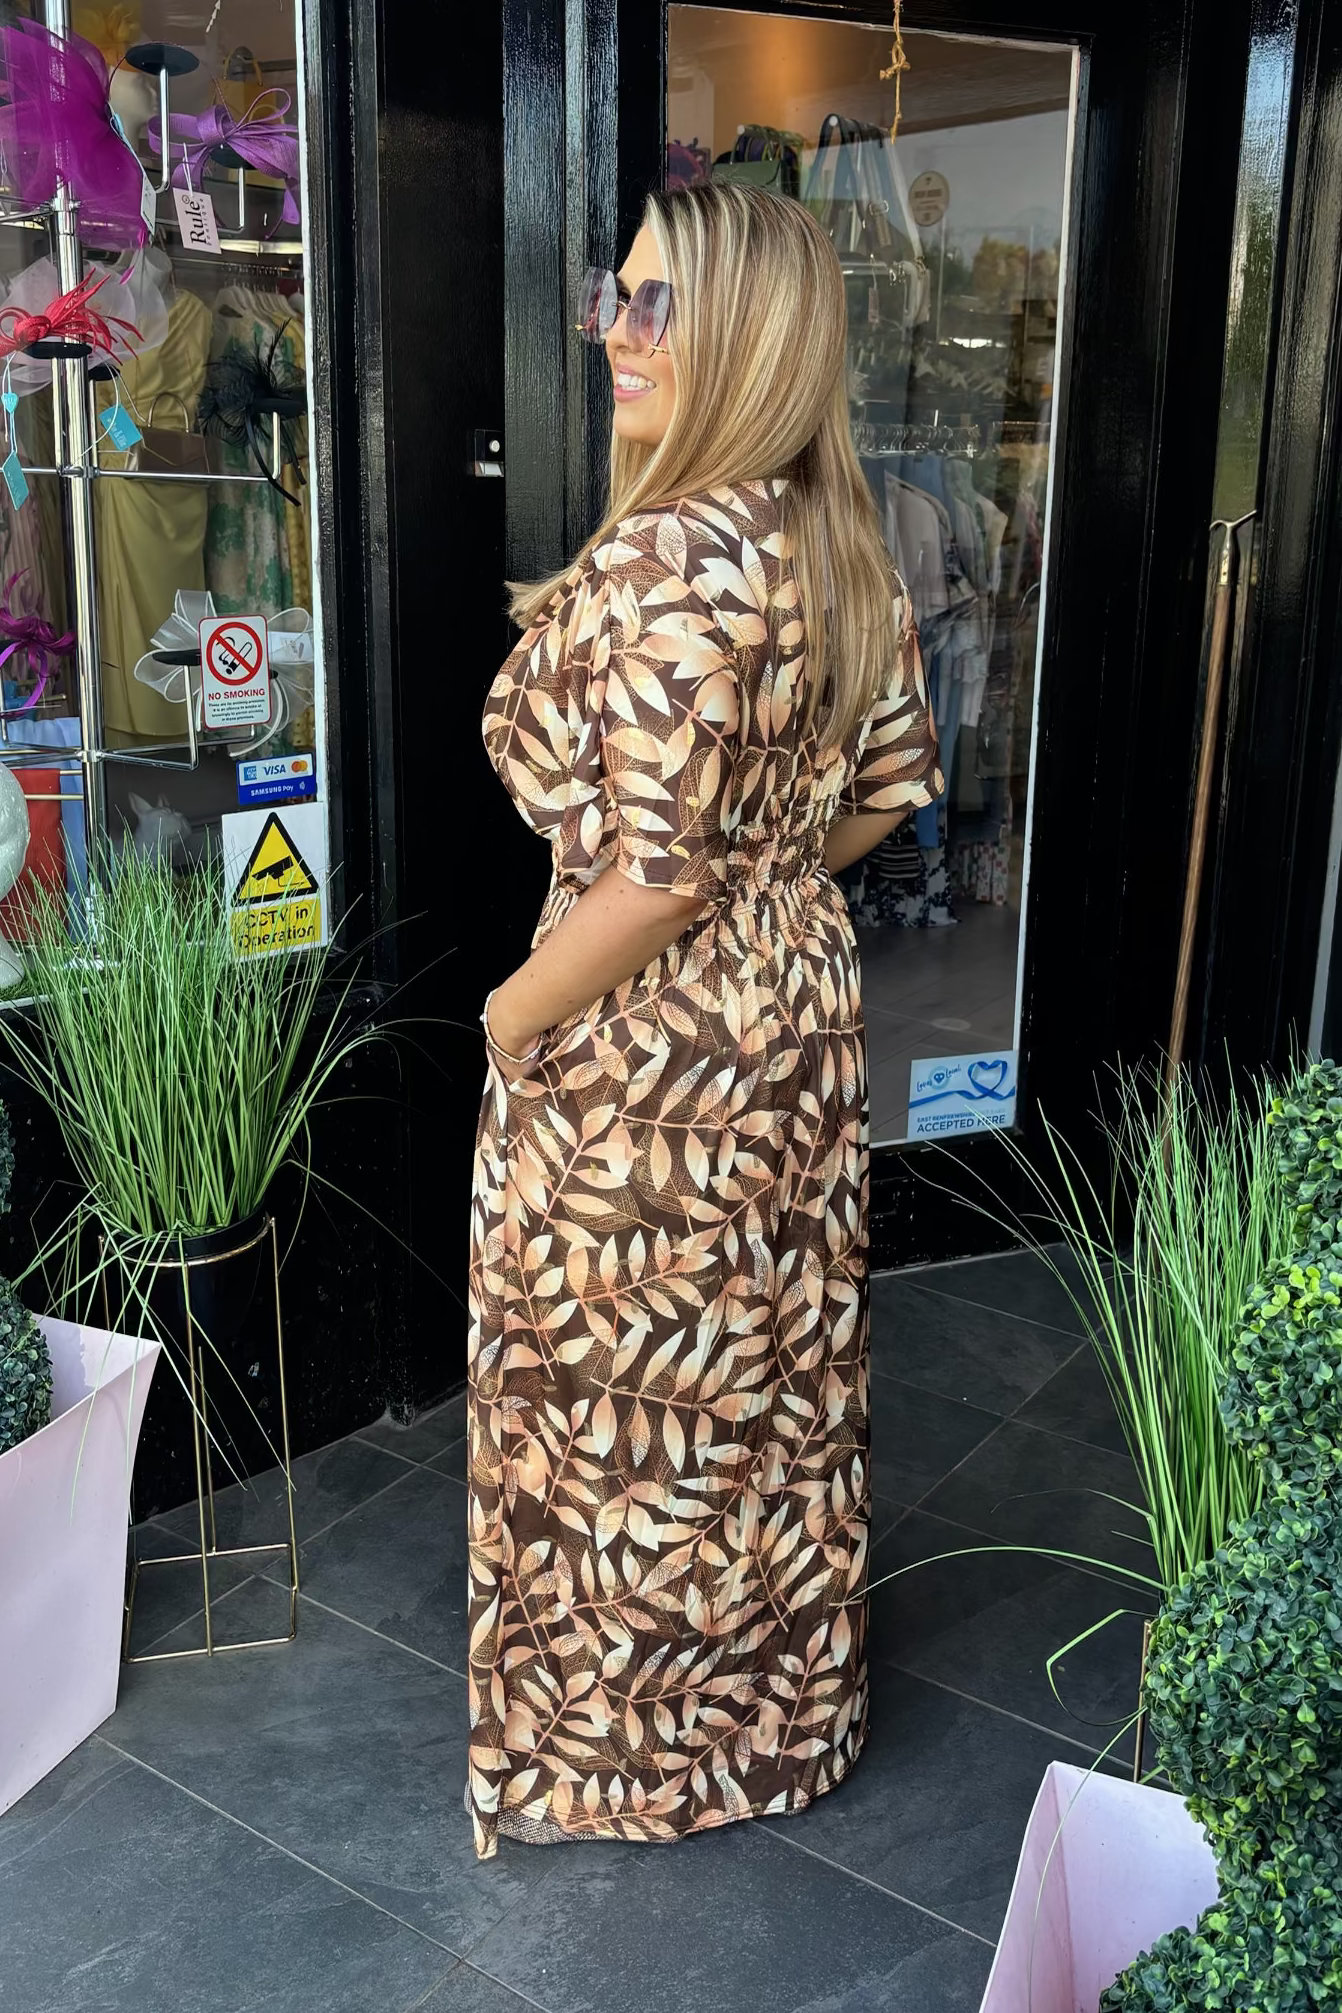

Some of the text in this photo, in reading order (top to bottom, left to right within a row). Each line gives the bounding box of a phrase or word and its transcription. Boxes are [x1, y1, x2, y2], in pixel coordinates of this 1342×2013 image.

[185, 201, 207, 244] Rule
[208, 688, 265, 701] NO SMOKING
[263, 764, 286, 776] VISA
[250, 785, 282, 797] SAMSUNG
[246, 906, 309, 929] CCTV in
[239, 925, 315, 950] Operation
[916, 1114, 1006, 1133] ACCEPTED HERE
